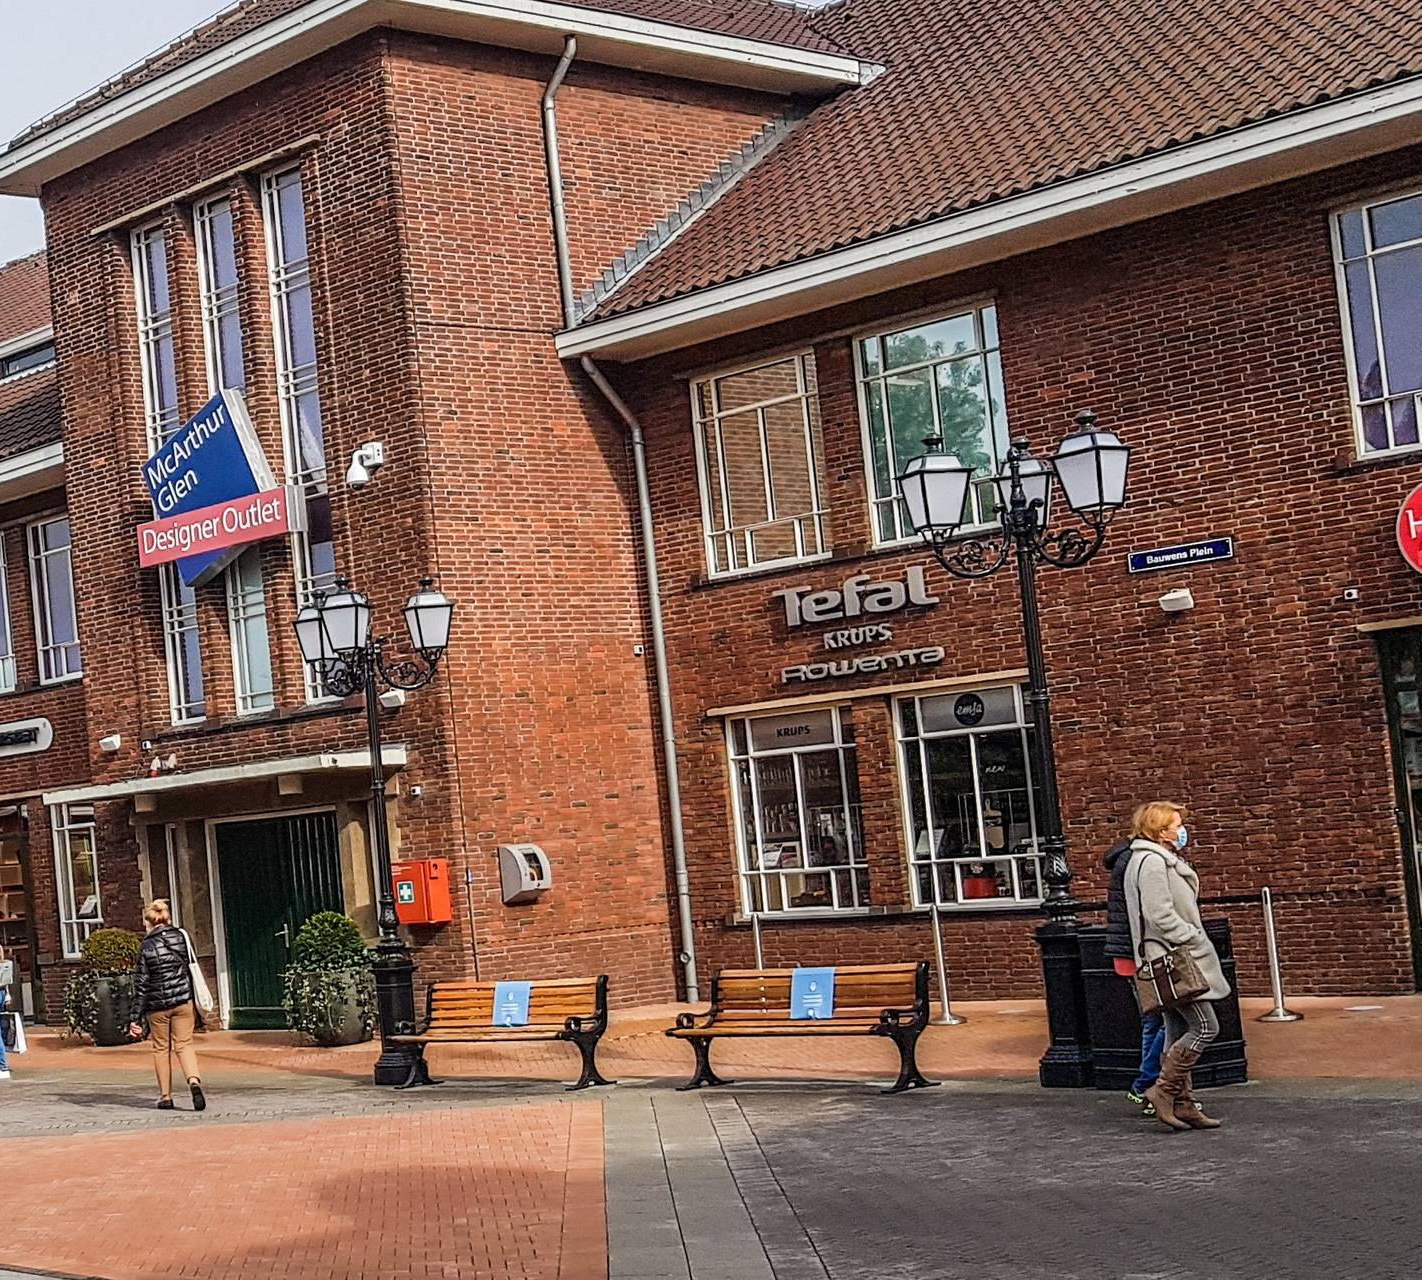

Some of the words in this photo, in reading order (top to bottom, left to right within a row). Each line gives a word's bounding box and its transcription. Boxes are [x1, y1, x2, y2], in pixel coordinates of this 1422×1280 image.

[147, 404, 226, 490] McArthur
[157, 469, 198, 512] Glen
[143, 516, 220, 554] Designer
[223, 498, 282, 533] Outlet
[1146, 551, 1188, 564] Bauwens
[1190, 547, 1214, 558] Plein
[772, 565, 940, 627] Tefal
[823, 623, 892, 649] KRUPS
[777, 724, 811, 738] KRUPS
